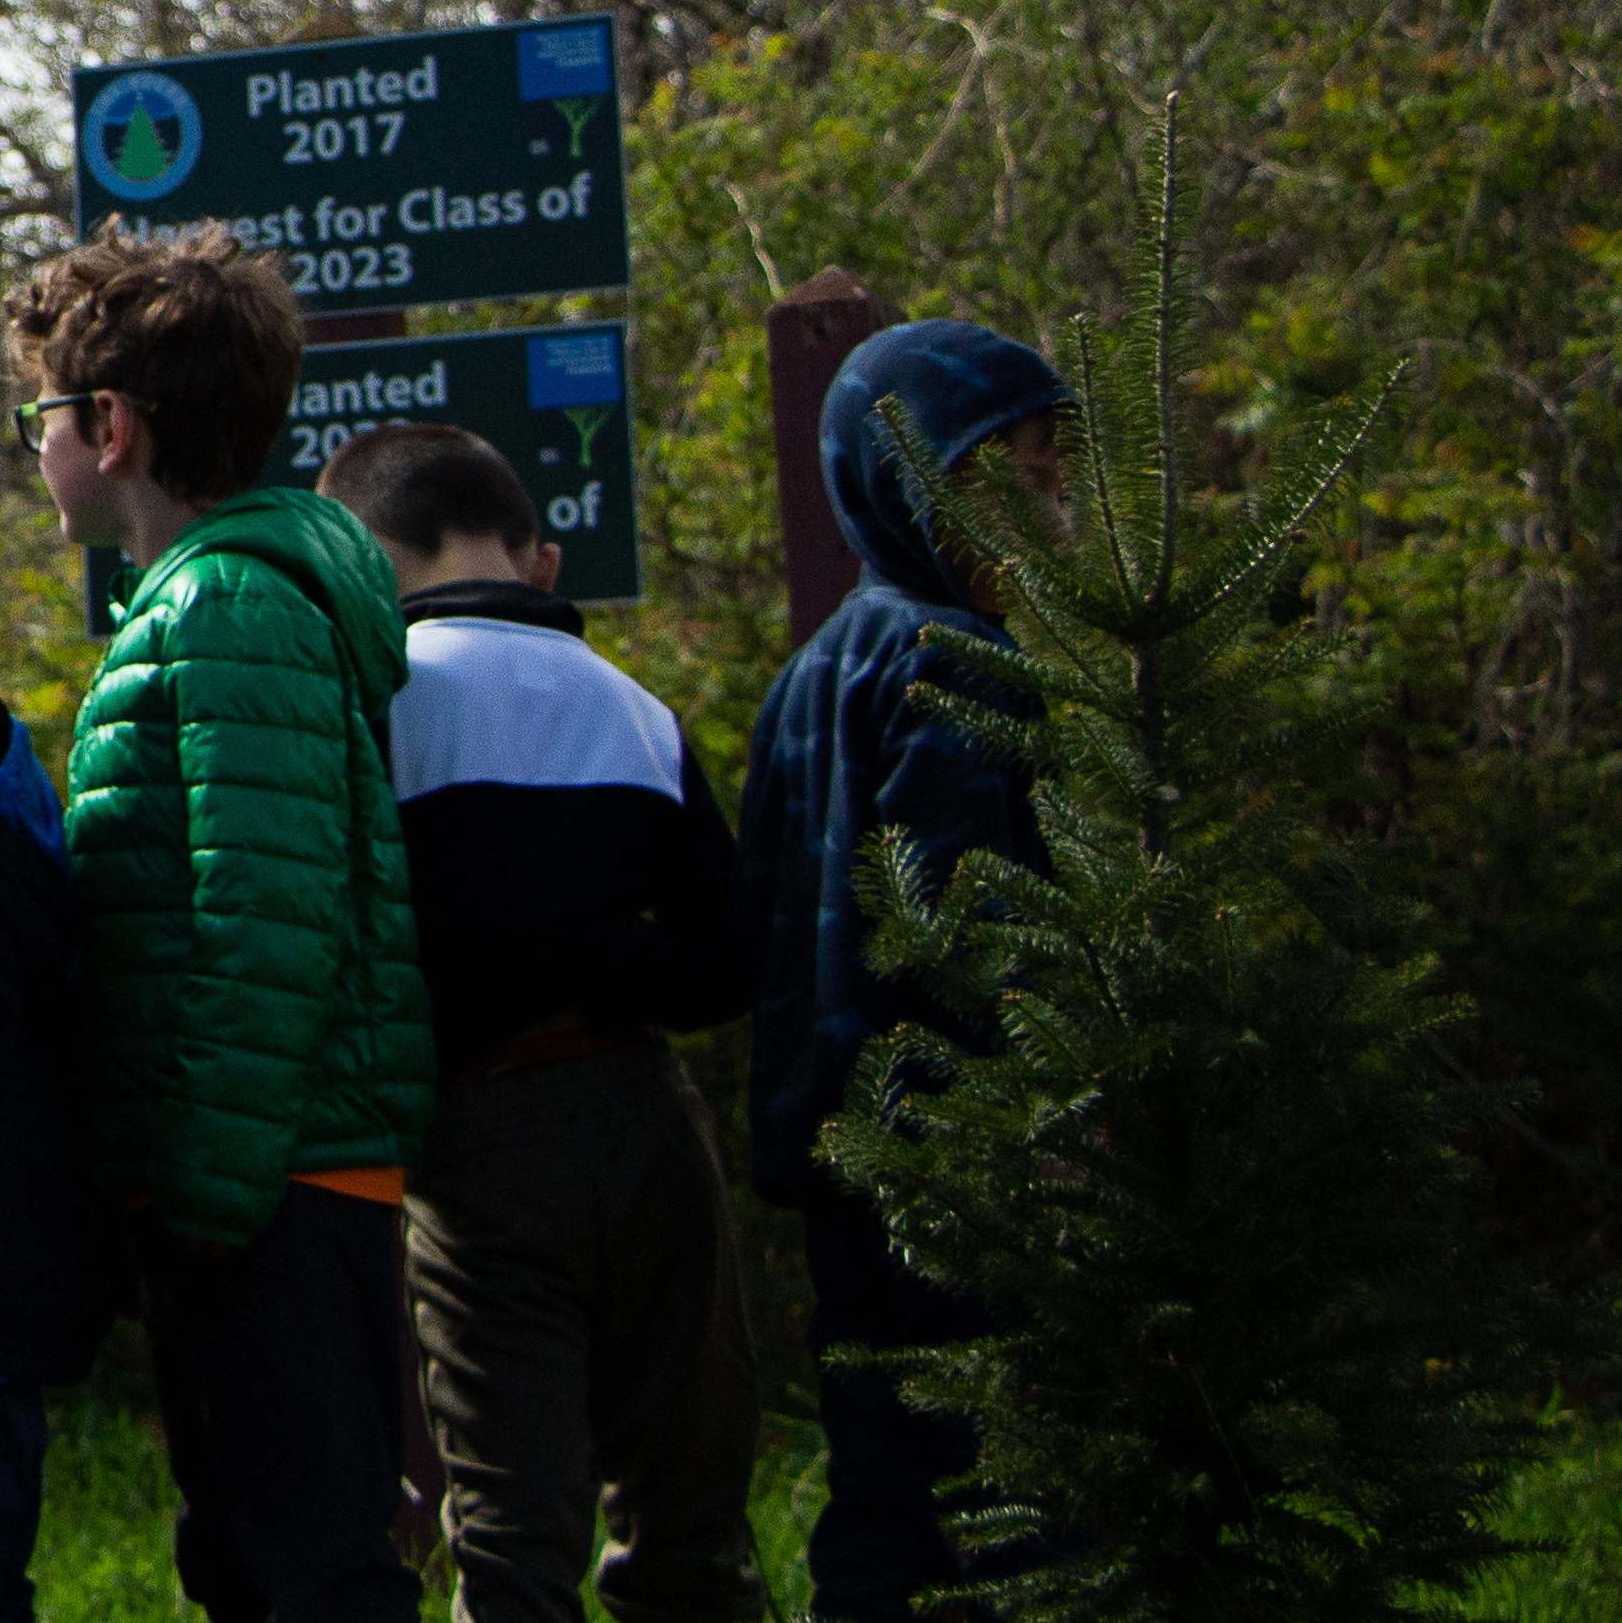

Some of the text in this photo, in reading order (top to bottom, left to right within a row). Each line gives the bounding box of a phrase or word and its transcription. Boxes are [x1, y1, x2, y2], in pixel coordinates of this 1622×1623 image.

[246, 55, 438, 118] Planted
[283, 113, 405, 164] 2017
[116, 172, 593, 249] Harest for Class of
[293, 244, 413, 294] 2023
[290, 360, 447, 417] lanted
[293, 419, 412, 468] 20
[548, 482, 601, 530] of
